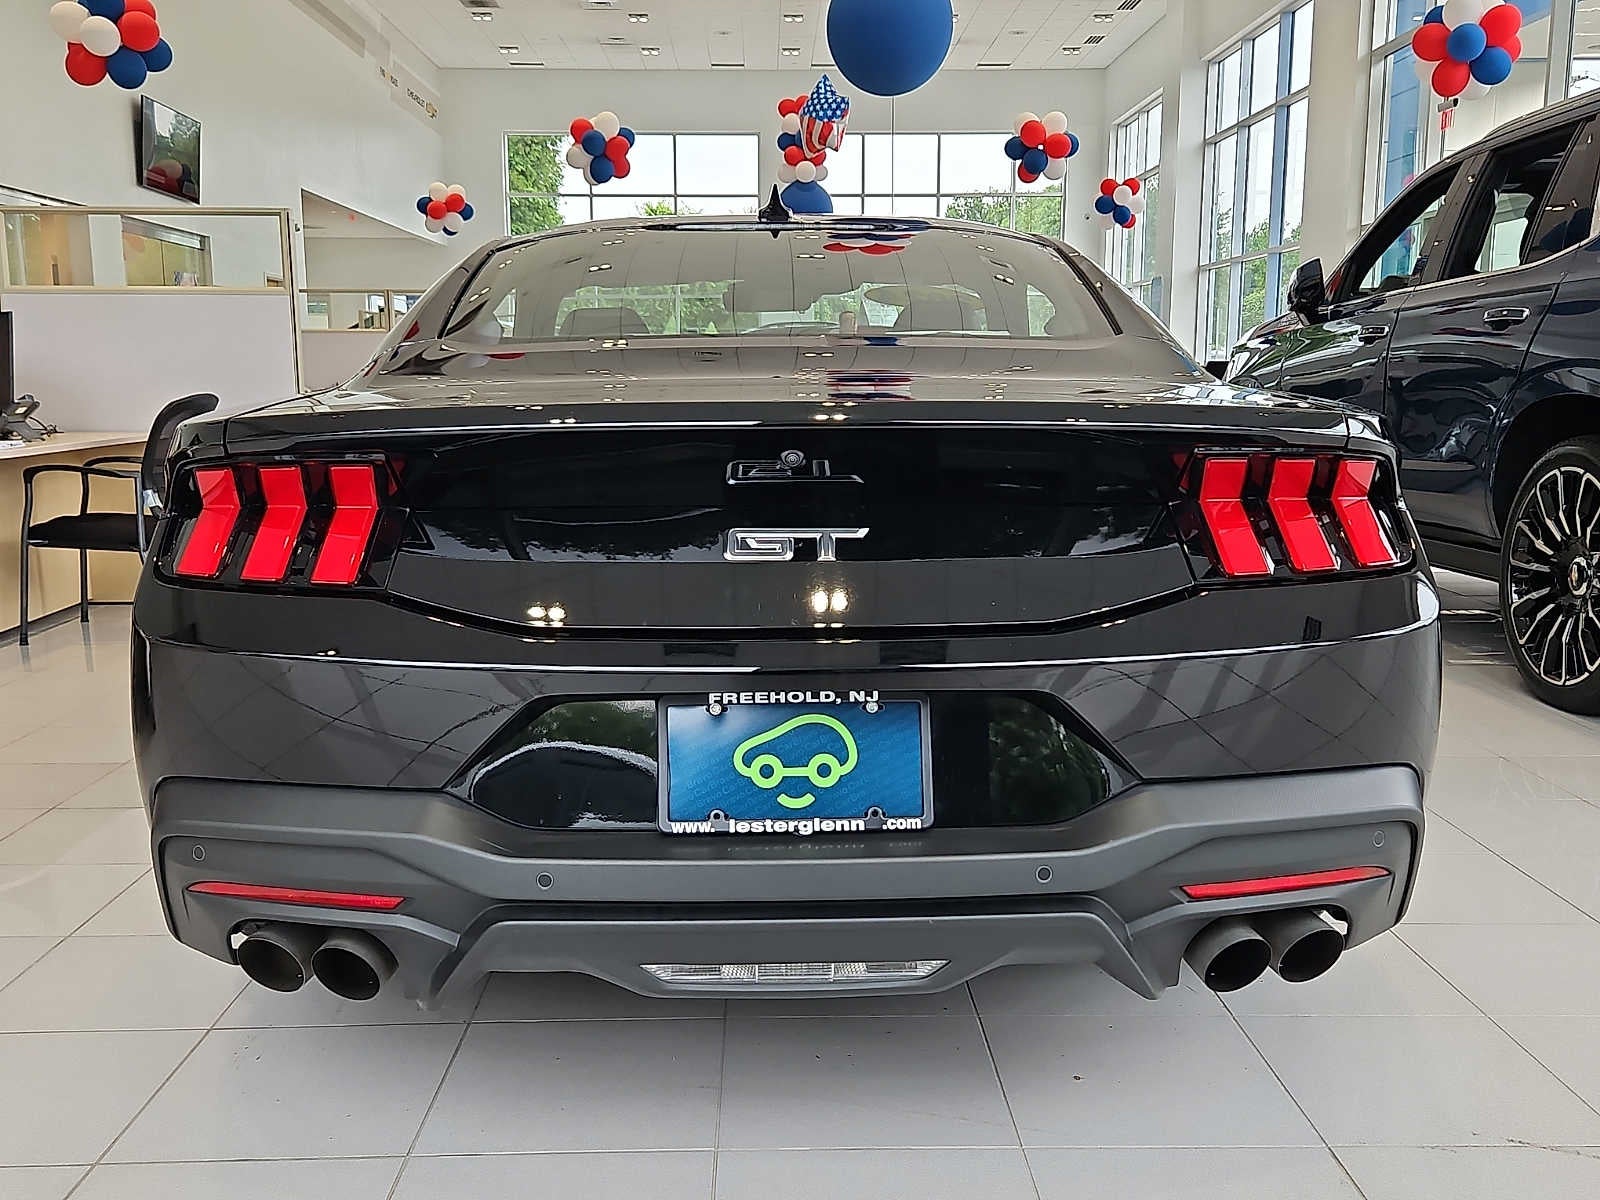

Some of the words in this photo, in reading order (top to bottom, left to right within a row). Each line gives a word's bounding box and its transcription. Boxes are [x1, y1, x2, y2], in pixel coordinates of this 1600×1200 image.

[724, 527, 870, 561] GT
[708, 691, 841, 704] FREEHOLD,
[849, 690, 879, 702] NJ
[671, 821, 715, 834] www.
[729, 818, 865, 835] lesterglenn
[882, 818, 922, 830] .com
